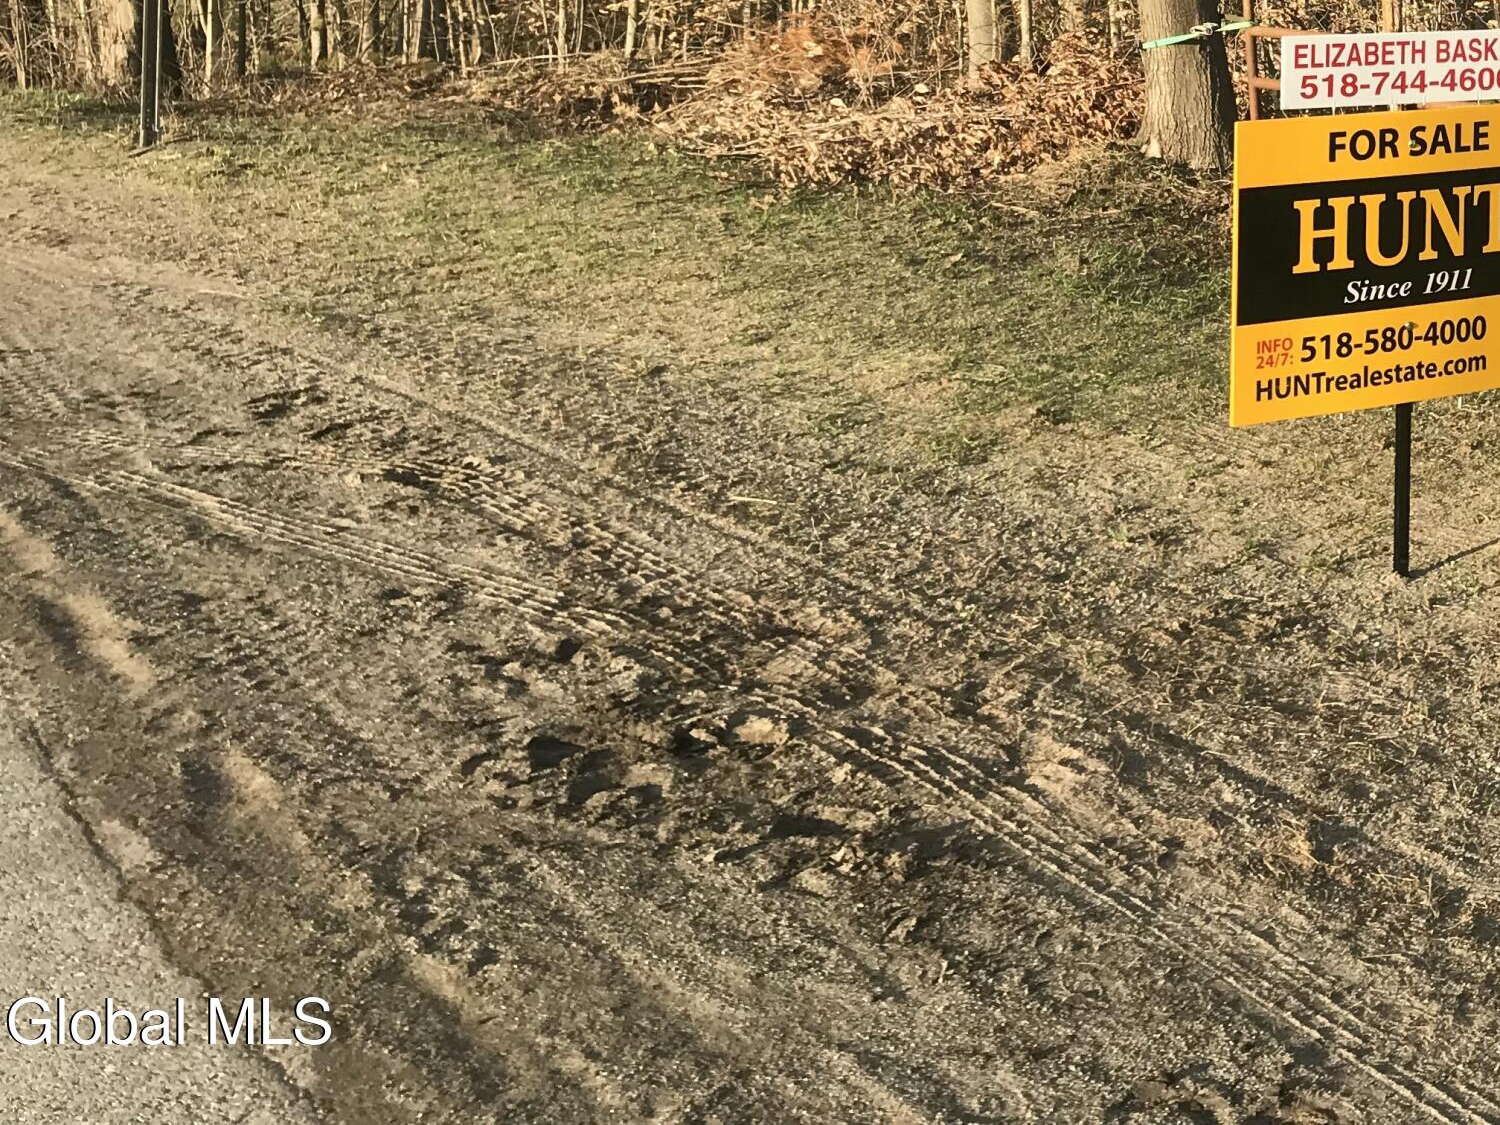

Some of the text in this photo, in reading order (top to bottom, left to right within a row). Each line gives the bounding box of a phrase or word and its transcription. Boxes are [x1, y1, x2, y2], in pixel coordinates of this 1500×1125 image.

[1293, 40, 1427, 69] ELIZABETH
[1328, 120, 1490, 163] FOR SALE
[1344, 268, 1473, 305] Since 1911
[1256, 337, 1294, 355] INFO
[1300, 315, 1488, 363] 518-580-4000
[1255, 352, 1295, 370] 24/7:
[1255, 354, 1488, 402] HUNTrealestate.com
